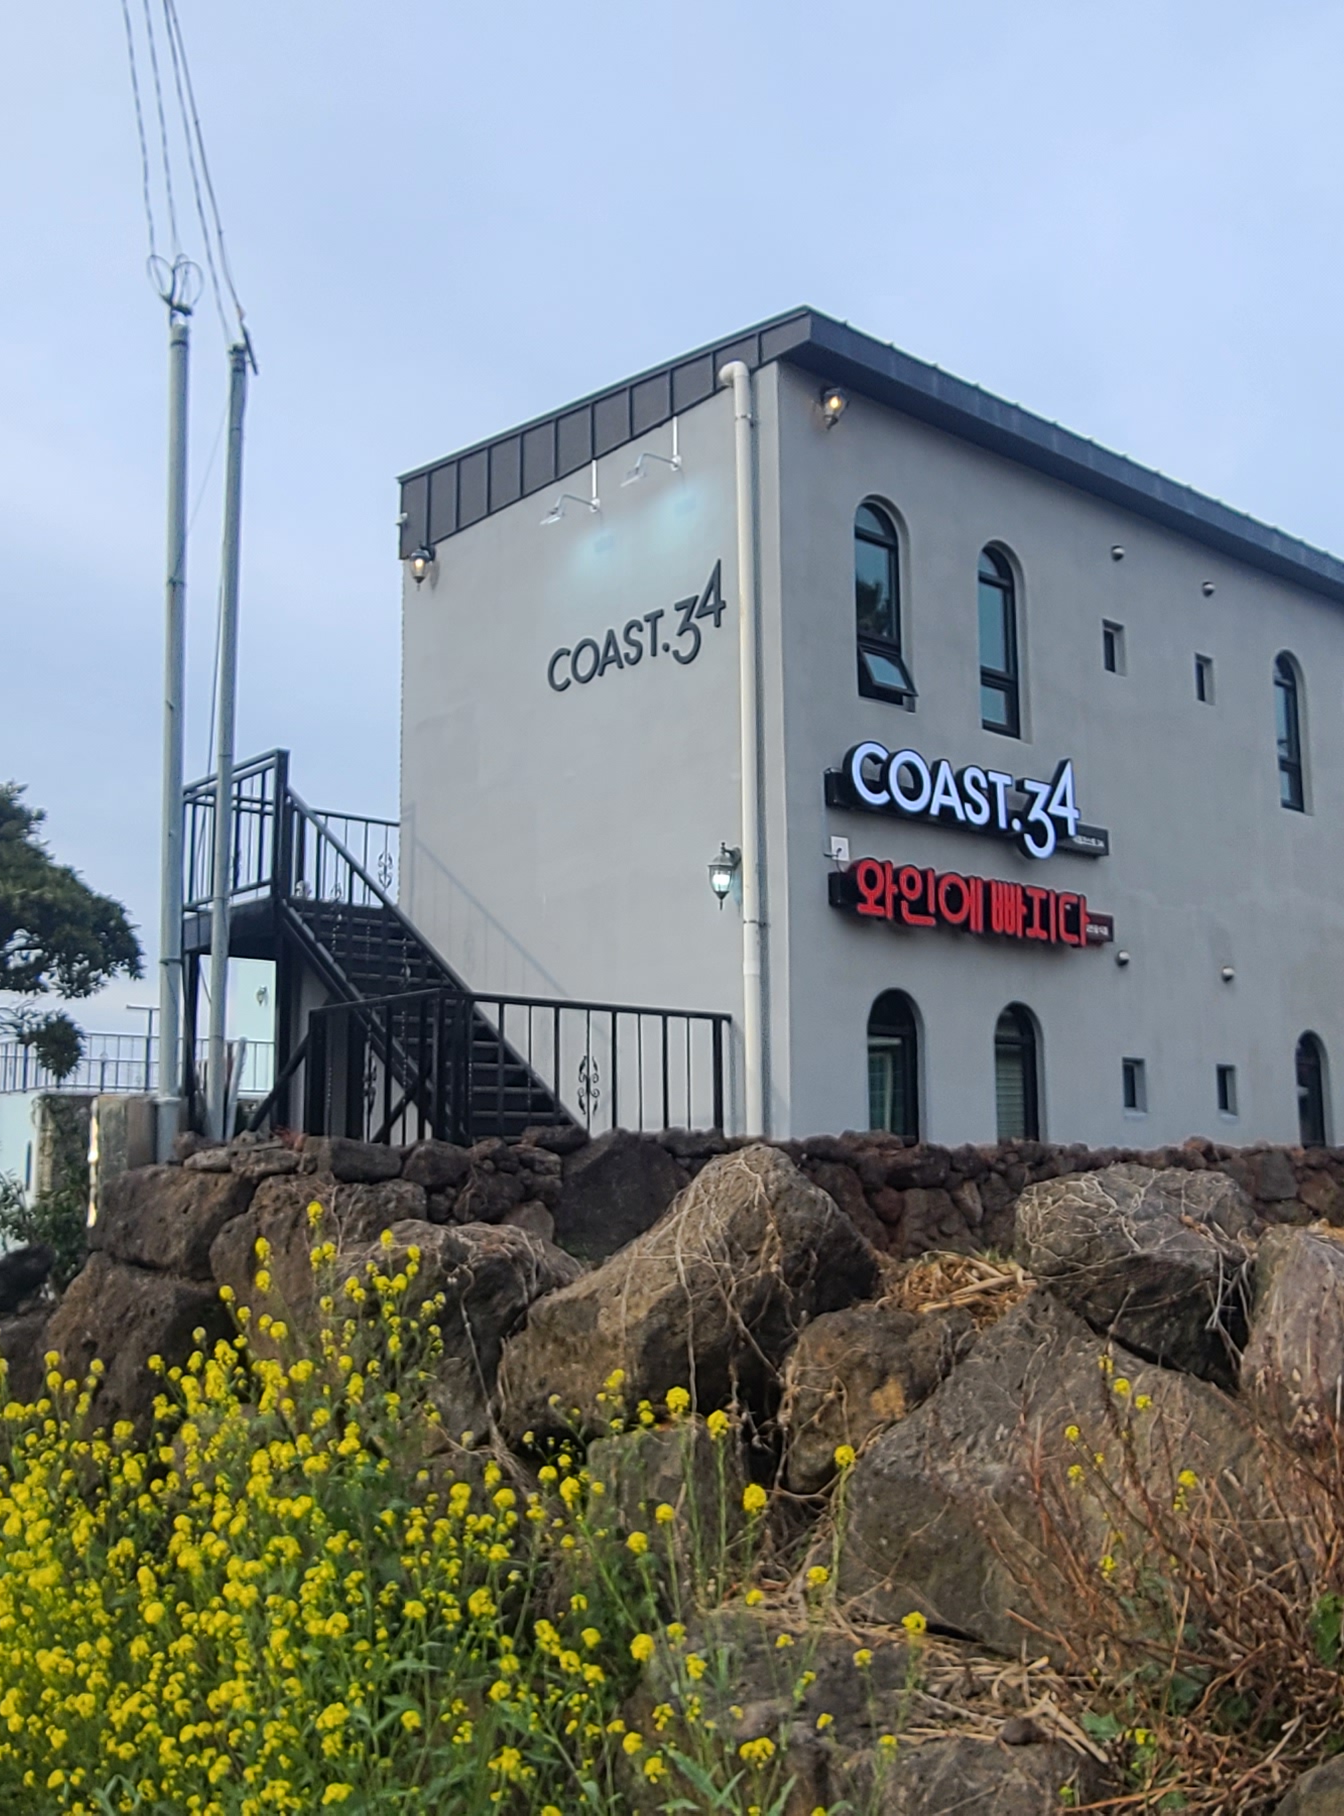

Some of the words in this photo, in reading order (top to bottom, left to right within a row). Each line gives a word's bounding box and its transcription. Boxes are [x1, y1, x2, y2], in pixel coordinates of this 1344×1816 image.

[547, 558, 727, 692] COAST.34
[846, 742, 1080, 859] COAST.34
[856, 858, 984, 934] 와인에
[990, 880, 1091, 946] 빠지다
